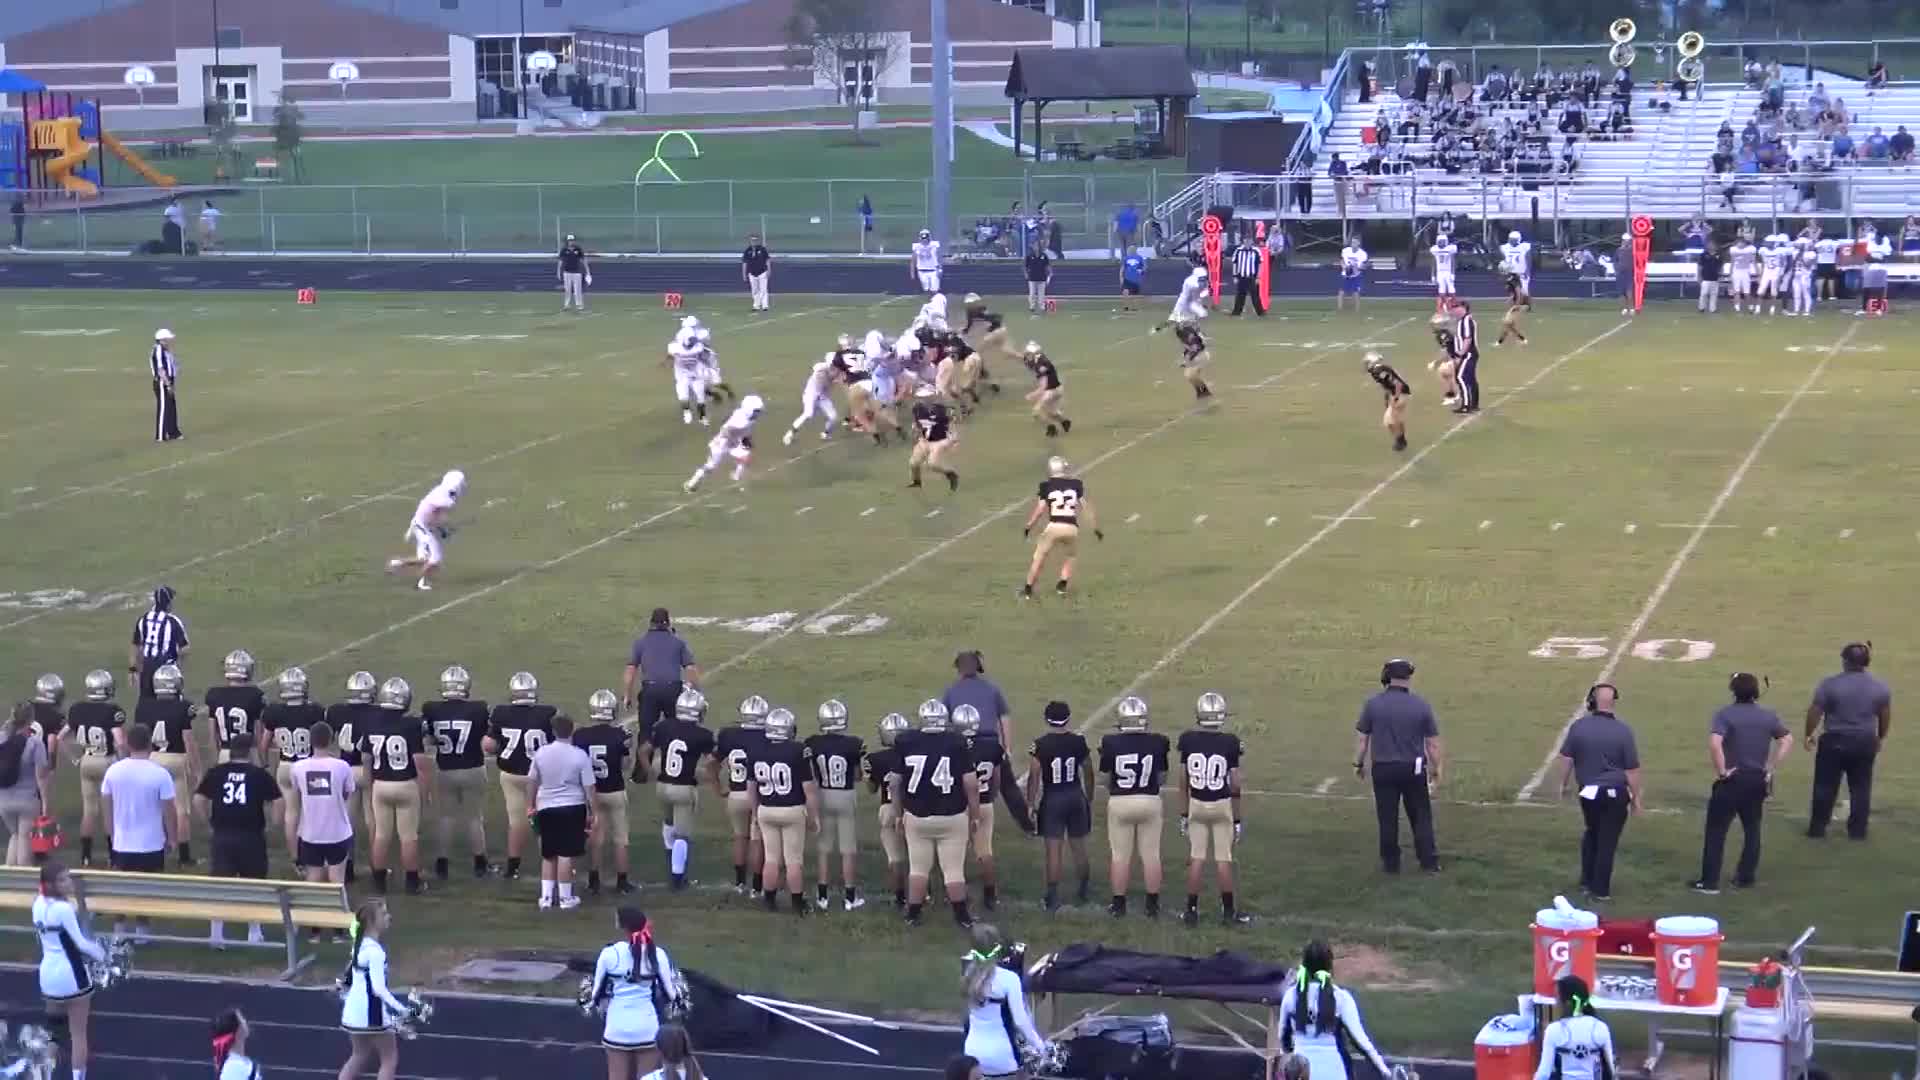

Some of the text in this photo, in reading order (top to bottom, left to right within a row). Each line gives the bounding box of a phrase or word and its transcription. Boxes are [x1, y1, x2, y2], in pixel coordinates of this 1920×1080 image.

[1528, 637, 1715, 662] 50
[215, 706, 248, 741] 13
[434, 720, 472, 754] 57
[500, 727, 548, 761] 70
[666, 739, 688, 777] 6
[754, 761, 792, 796] 90
[816, 754, 847, 789] 18
[904, 754, 954, 794] 74
[1051, 757, 1076, 784] 11
[1115, 752, 1153, 789] 51
[1187, 752, 1227, 791] 90
[222, 782, 247, 805] 34
[1550, 940, 1569, 962] G
[1672, 948, 1691, 970] G
